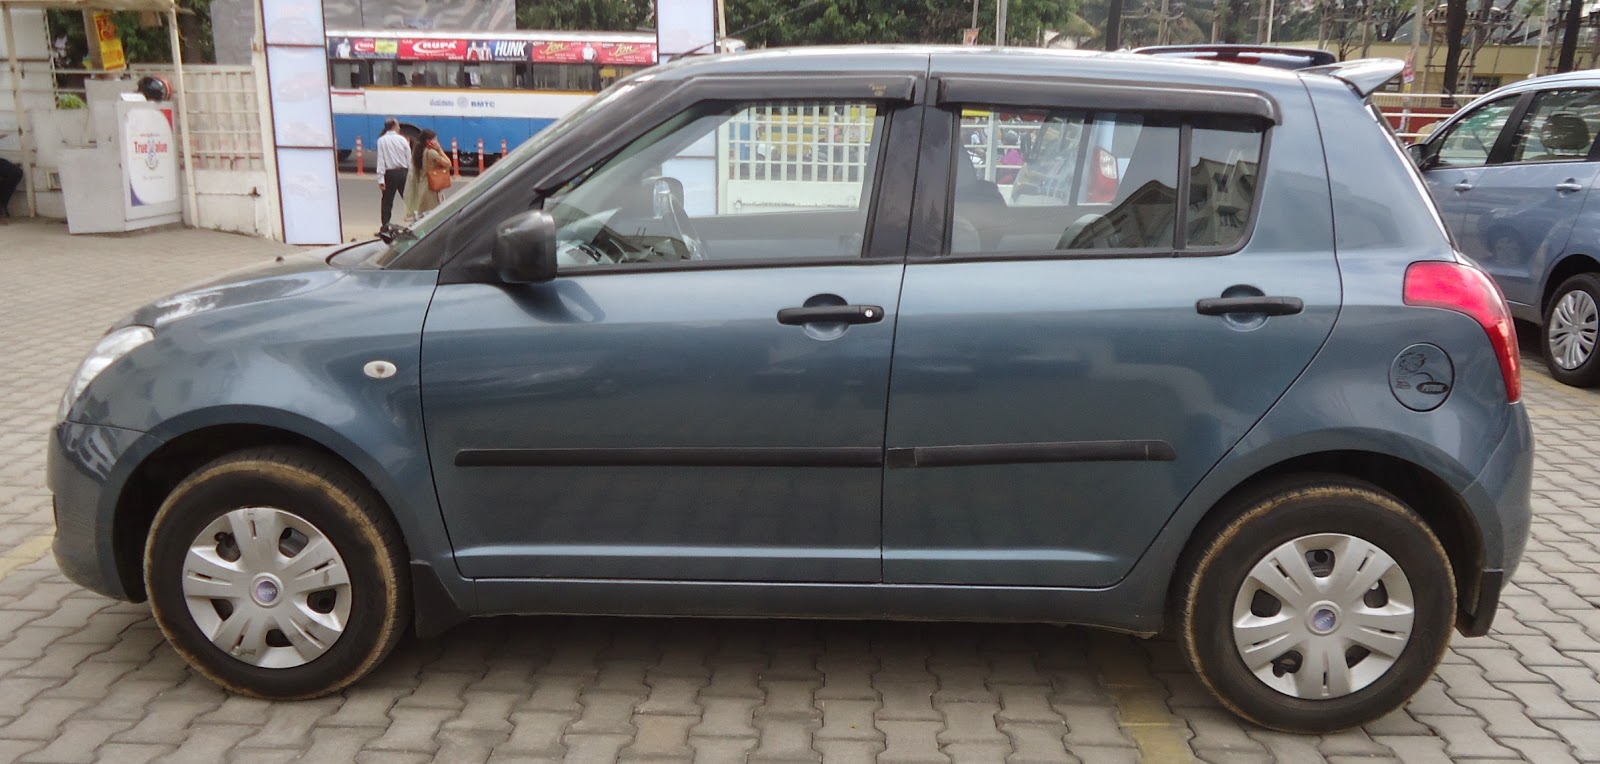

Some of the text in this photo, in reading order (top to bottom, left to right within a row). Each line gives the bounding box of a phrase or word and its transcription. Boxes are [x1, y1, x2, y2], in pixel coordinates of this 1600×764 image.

[422, 41, 456, 49] RUPA
[494, 41, 526, 57] HUNK
[134, 141, 148, 154] True
